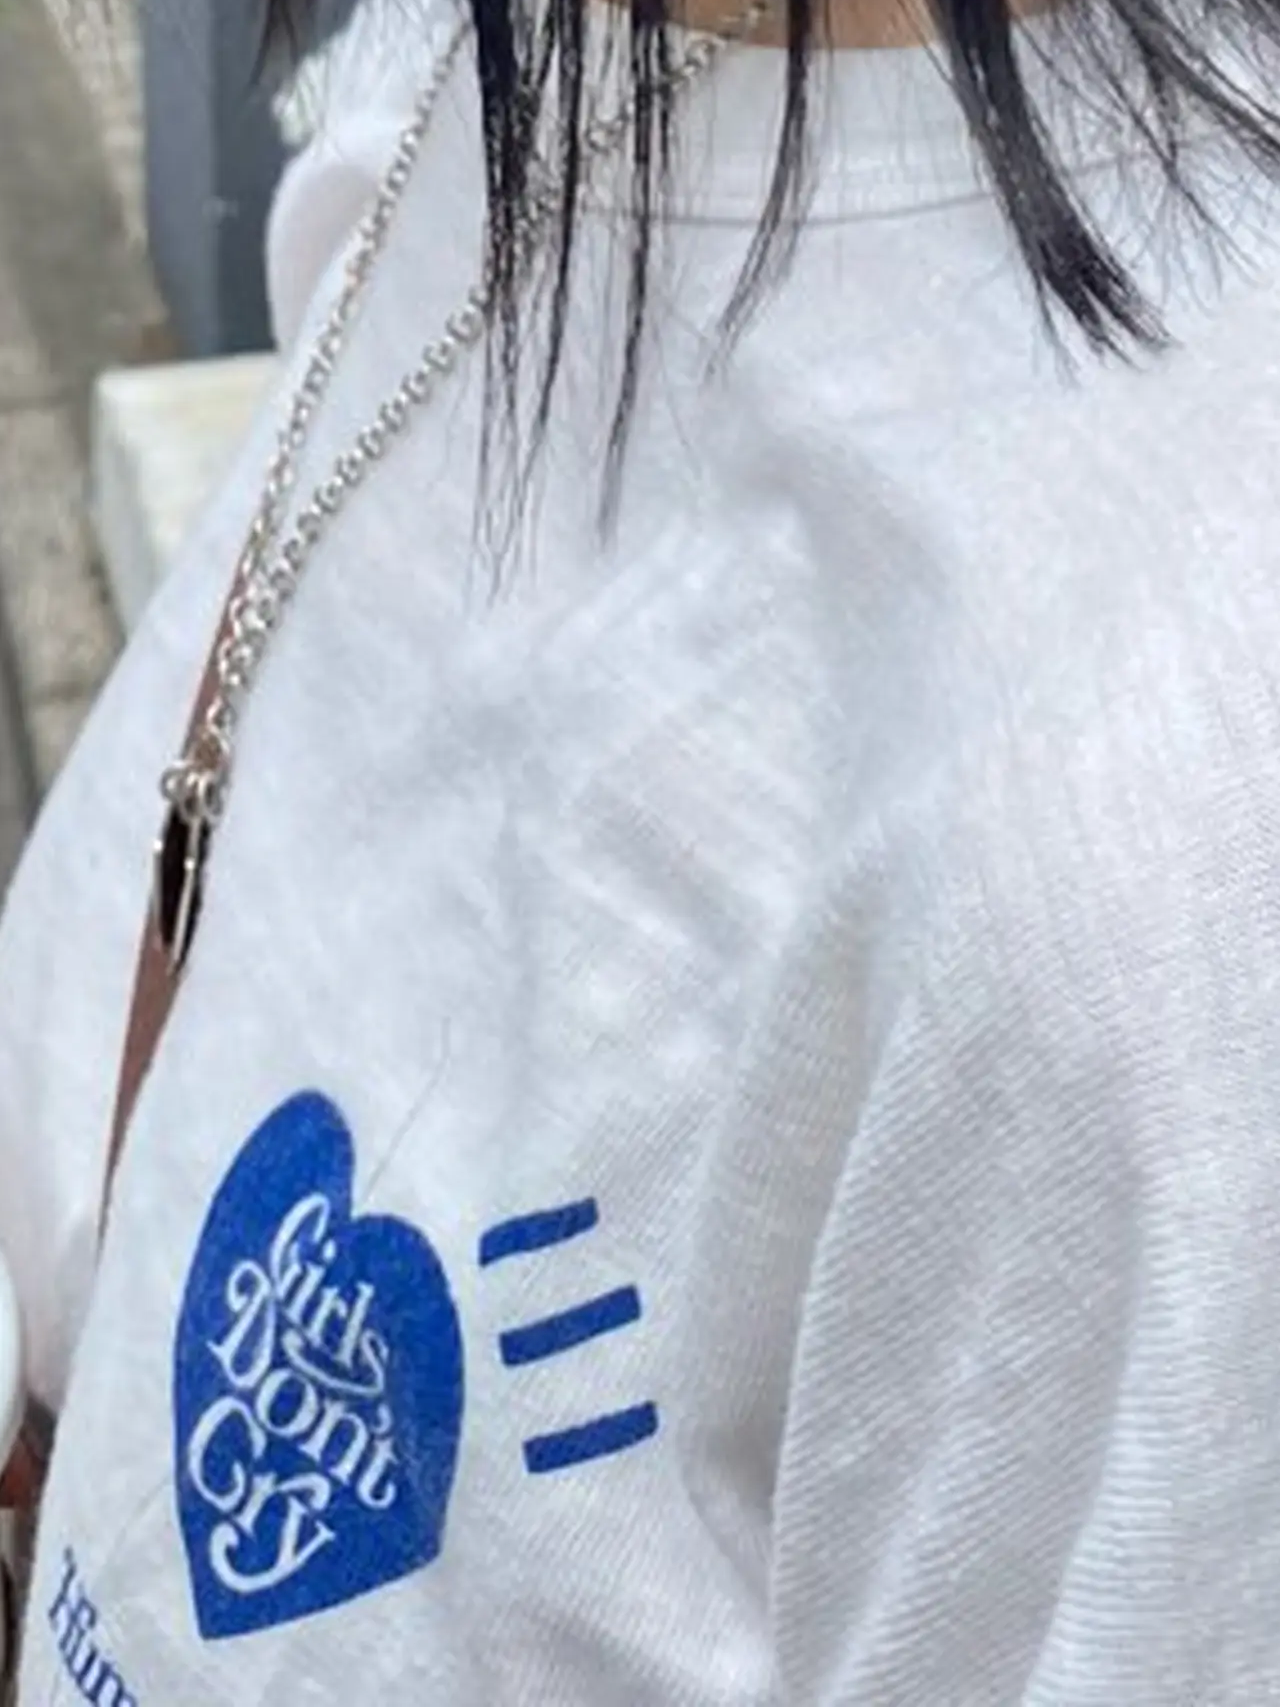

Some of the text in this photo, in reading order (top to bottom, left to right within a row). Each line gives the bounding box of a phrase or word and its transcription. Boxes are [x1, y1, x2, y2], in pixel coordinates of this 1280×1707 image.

[206, 1259, 399, 1509] Don't
[269, 1192, 388, 1396] Girls
[187, 1395, 336, 1592] Cry
